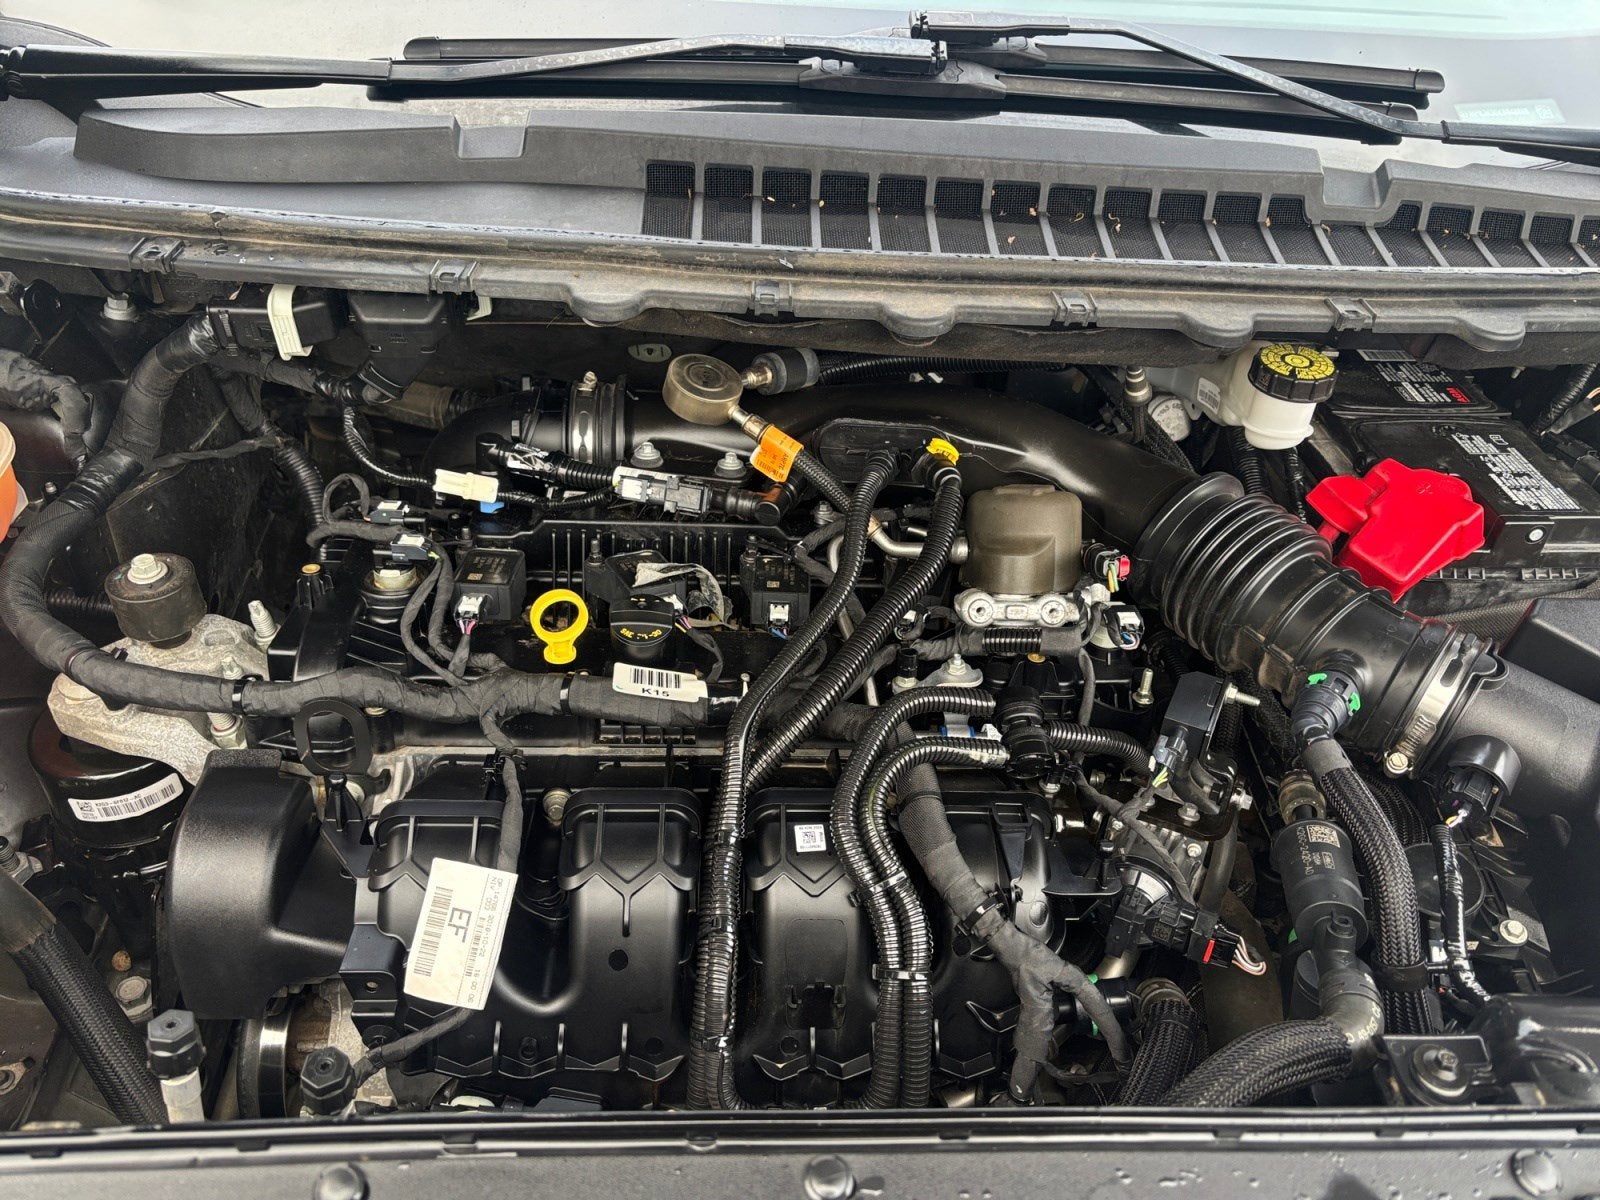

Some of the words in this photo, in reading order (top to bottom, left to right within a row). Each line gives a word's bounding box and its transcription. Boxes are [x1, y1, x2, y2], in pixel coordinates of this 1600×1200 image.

[620, 627, 635, 639] SAE
[641, 687, 670, 698] K15
[447, 907, 472, 944] EF
